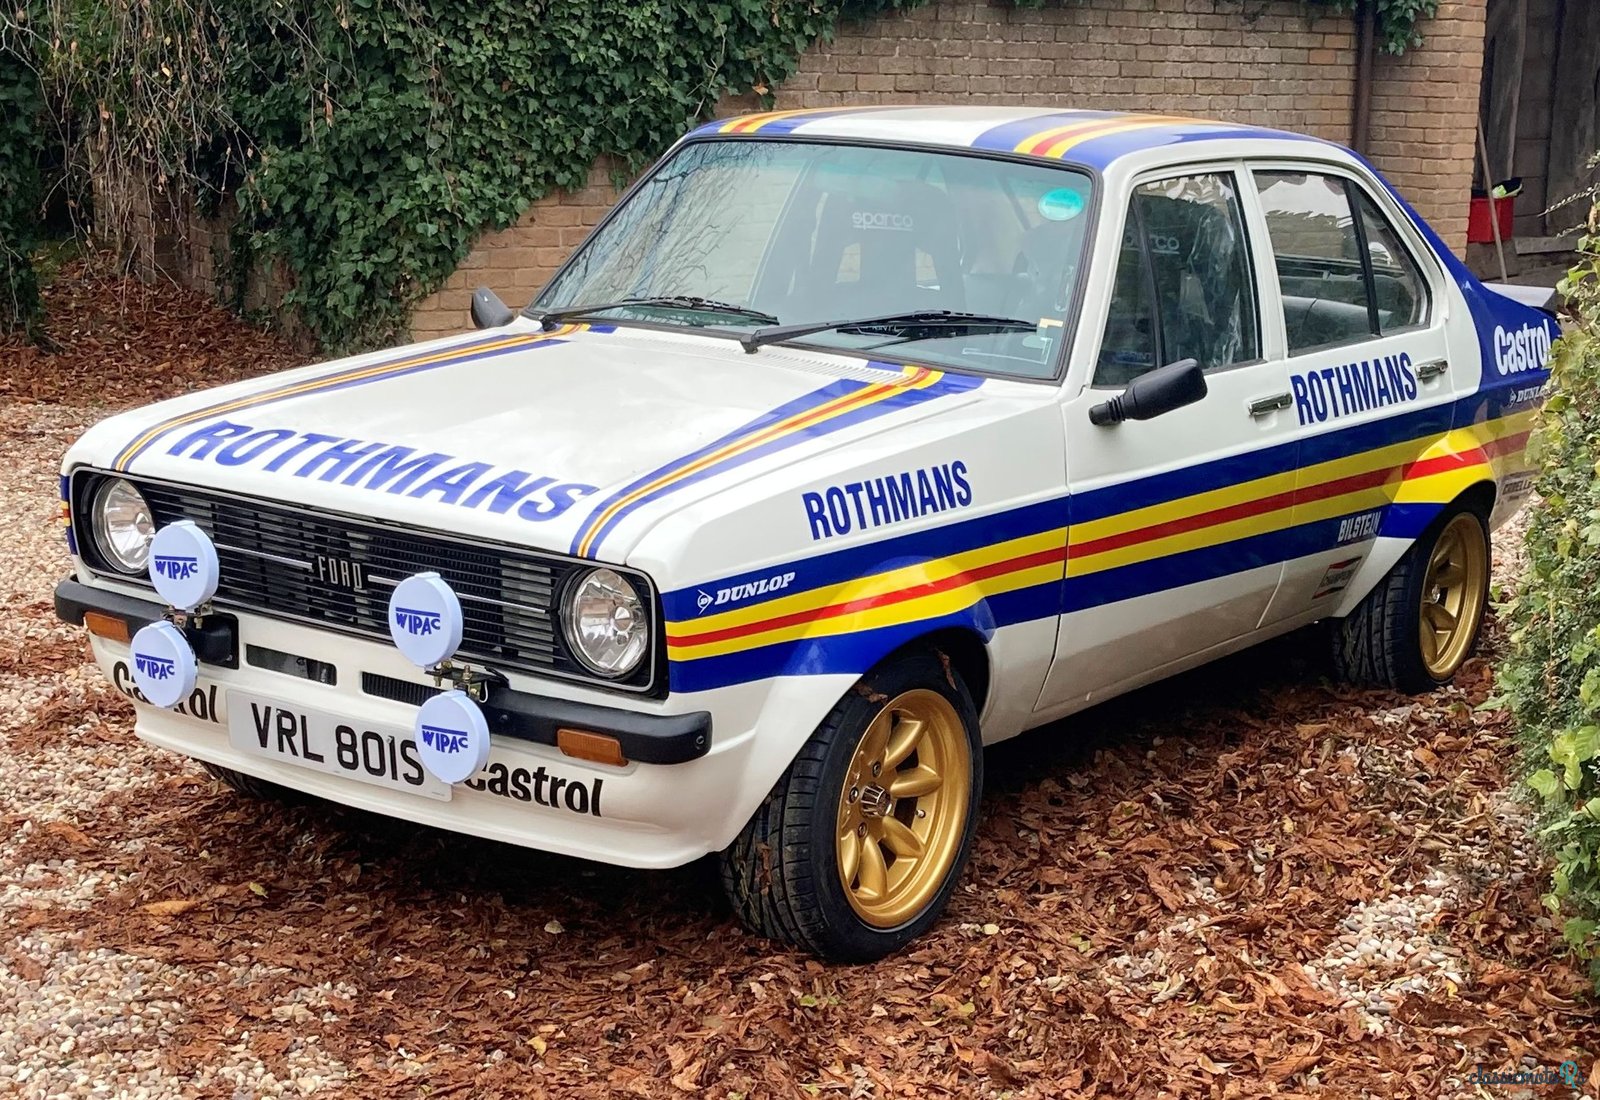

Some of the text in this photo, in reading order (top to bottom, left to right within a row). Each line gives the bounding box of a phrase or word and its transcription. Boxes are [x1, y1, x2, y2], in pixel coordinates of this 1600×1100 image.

[1494, 319, 1552, 375] Castrol
[1291, 352, 1417, 425] ROTHMANS
[167, 420, 599, 523] ROTHMANS
[802, 460, 972, 540] ROTHMANS
[1337, 511, 1382, 542] BILSTEIN
[155, 560, 198, 580] WIPAC
[318, 556, 363, 590] FORD
[714, 572, 796, 605] DUNLOP
[395, 612, 441, 636] WIPAC
[135, 658, 175, 680] WIPAC
[251, 702, 424, 786] VRL 801S
[422, 730, 469, 754] WIPAC
